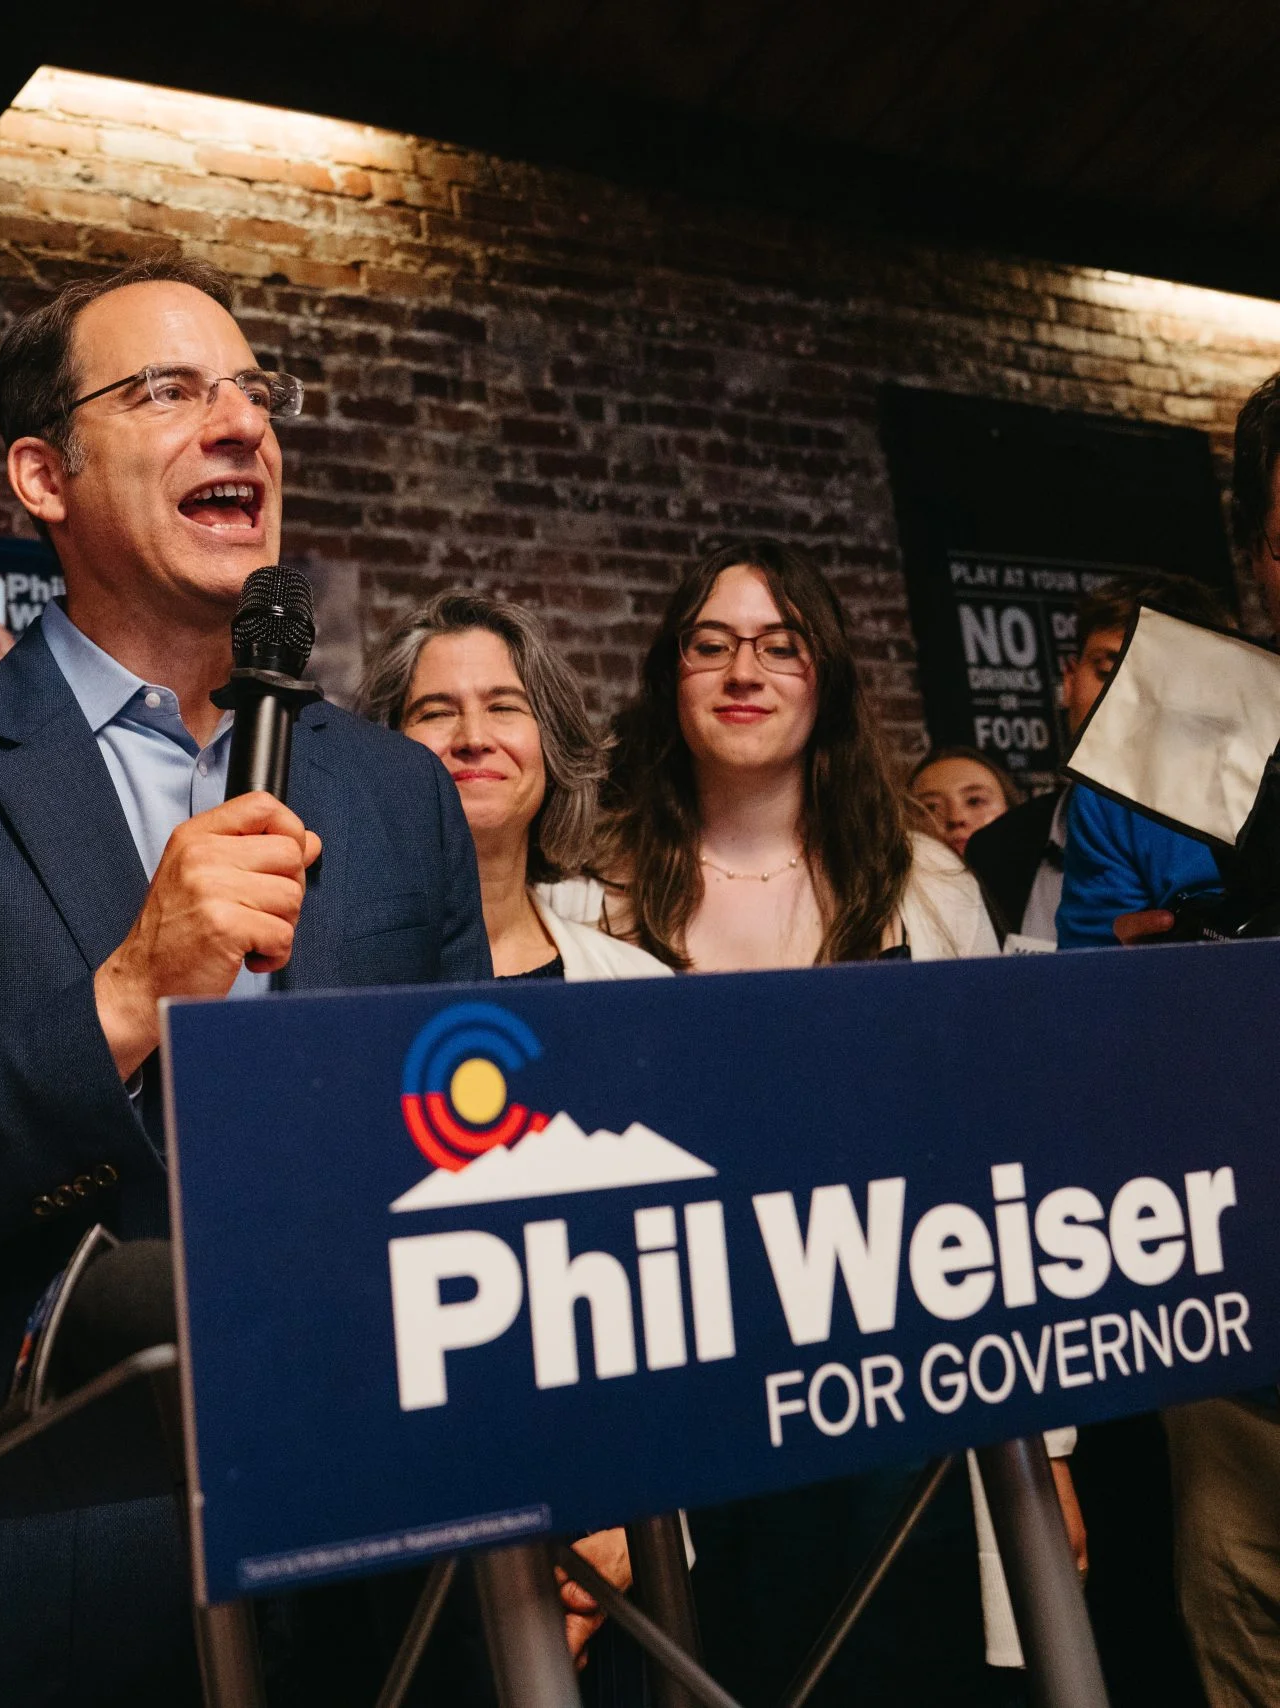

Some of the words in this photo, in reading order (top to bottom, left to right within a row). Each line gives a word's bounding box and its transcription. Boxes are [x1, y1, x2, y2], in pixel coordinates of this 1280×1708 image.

[6, 572, 67, 602] Phil
[950, 562, 997, 586] PLAY
[1029, 568, 1077, 592] YOUR
[958, 604, 1037, 668] NO
[967, 667, 1042, 692] DRINKS
[974, 715, 1049, 751] FOOD
[388, 1200, 736, 1411] Phil
[752, 1162, 1238, 1346] Weiser
[765, 1354, 906, 1448] FOR
[920, 1291, 1253, 1415] GOVERNOR
